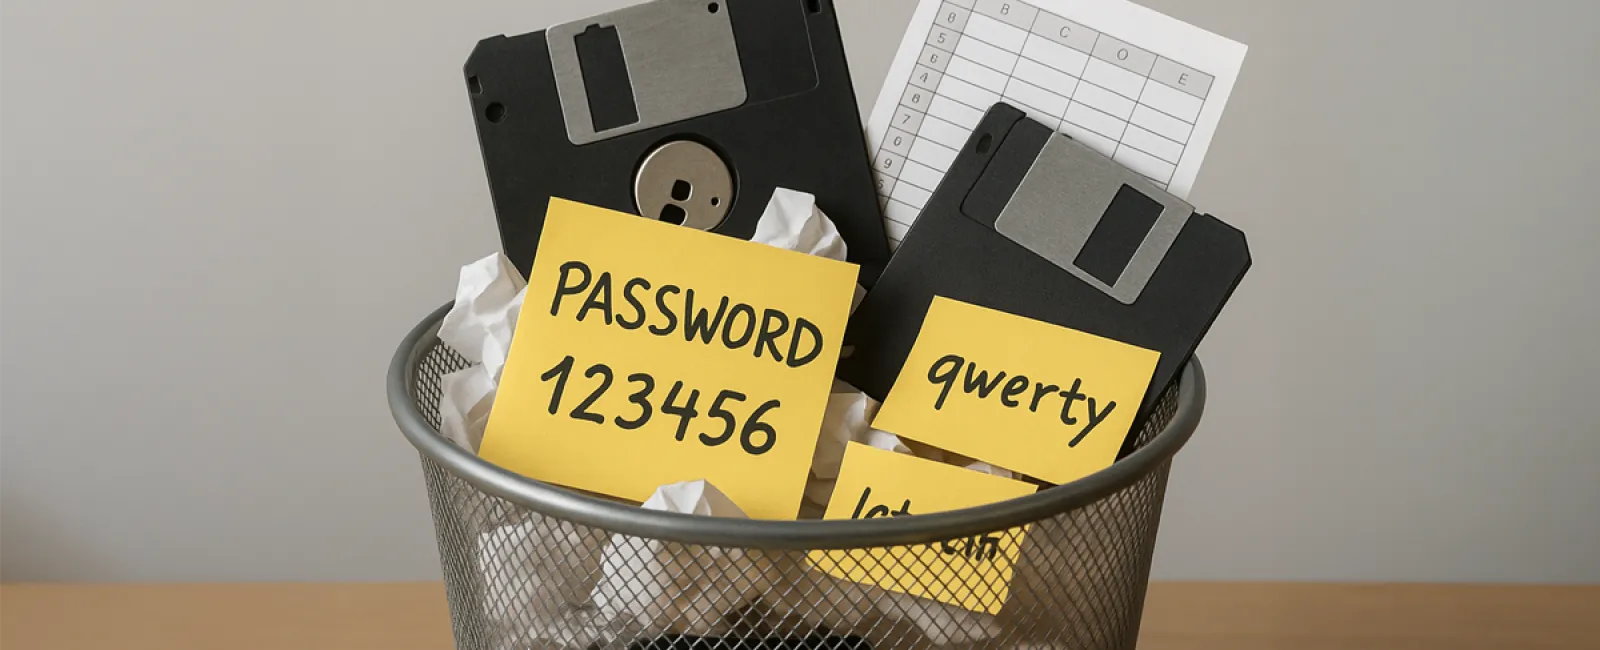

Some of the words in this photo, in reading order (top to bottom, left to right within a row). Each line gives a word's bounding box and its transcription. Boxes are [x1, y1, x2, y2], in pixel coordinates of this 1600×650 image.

[937, 32, 947, 44] 5
[1000, 3, 1011, 16] B
[1059, 26, 1071, 38] C
[1178, 73, 1189, 86] E
[902, 114, 911, 125] 7
[883, 158, 893, 169] 9
[550, 260, 823, 368] PASSWORD
[540, 354, 781, 455] 123456
[927, 353, 1117, 448] qwerty
